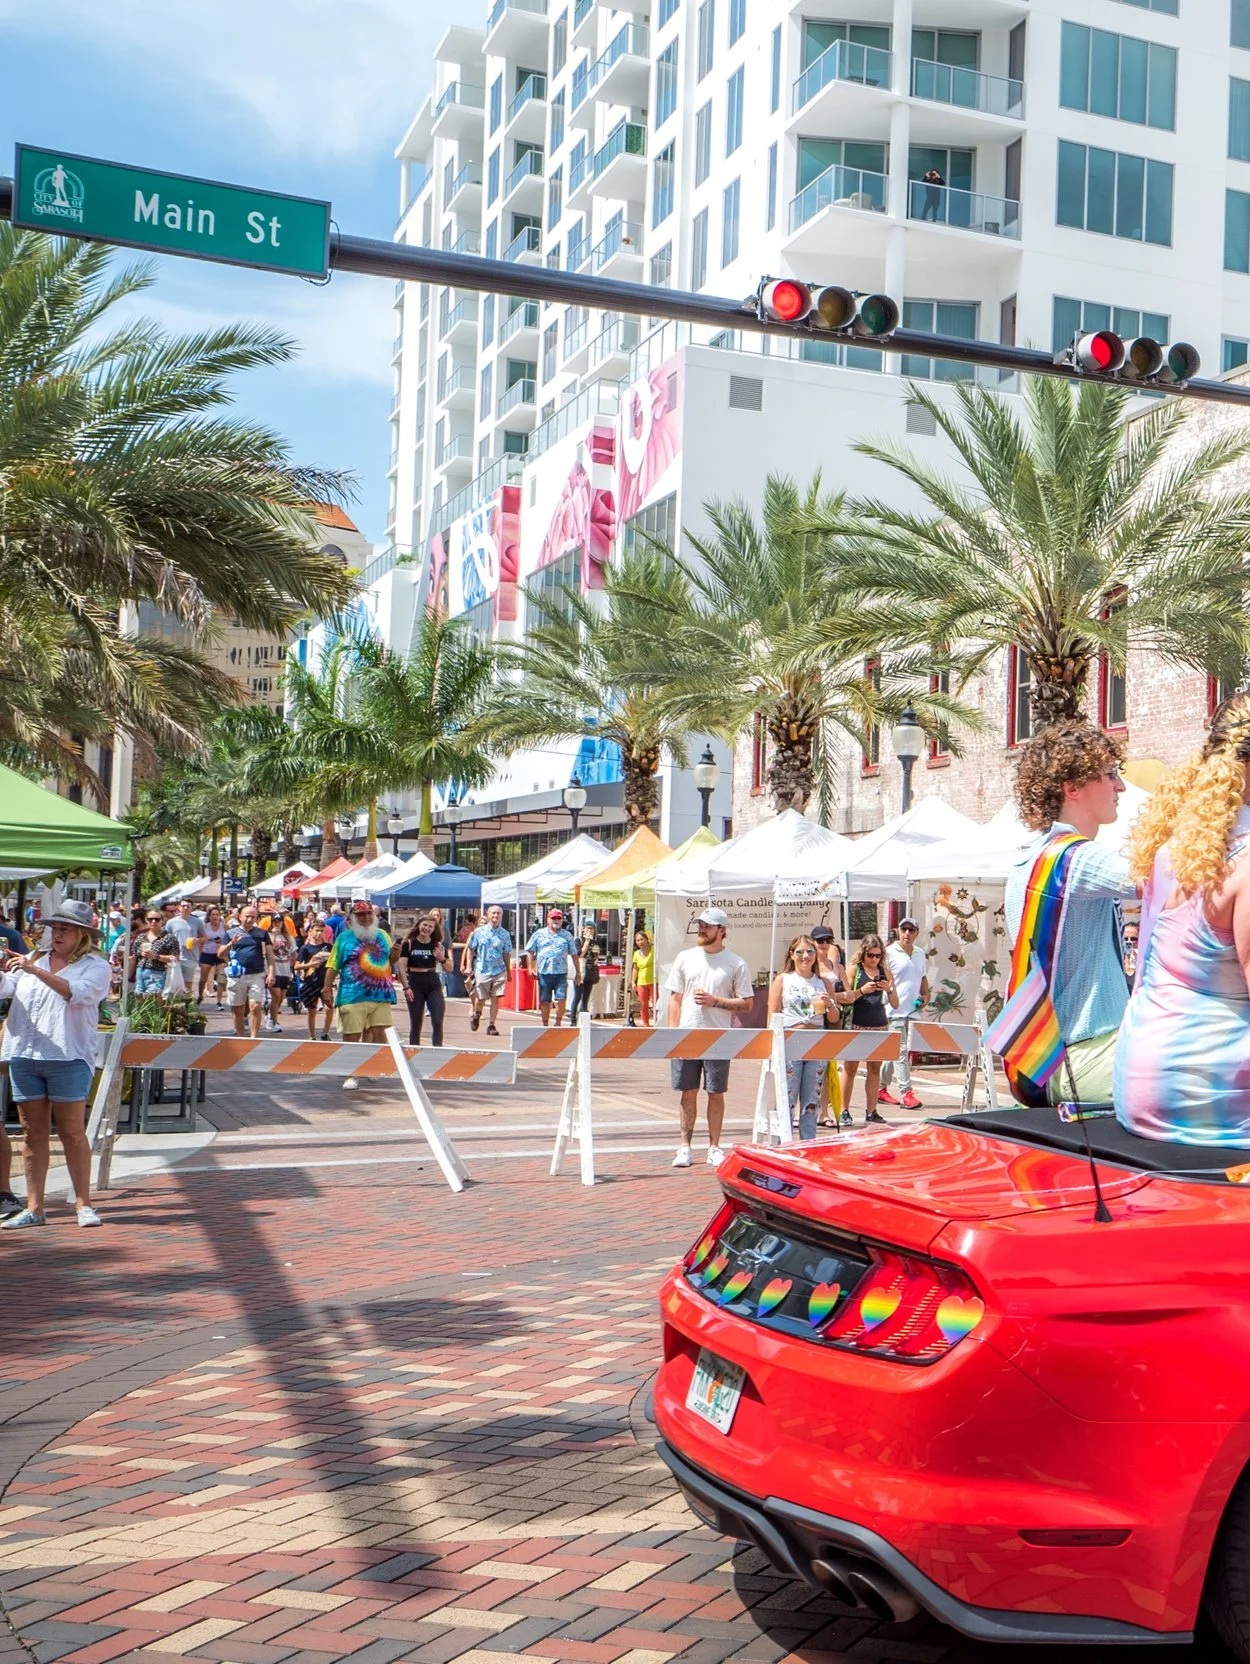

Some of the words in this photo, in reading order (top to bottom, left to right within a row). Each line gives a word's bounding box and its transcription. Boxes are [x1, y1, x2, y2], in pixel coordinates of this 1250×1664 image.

[134, 189, 215, 236] Main
[245, 210, 282, 247] St
[686, 898, 734, 908] Sarasota
[736, 897, 774, 907] Candle
